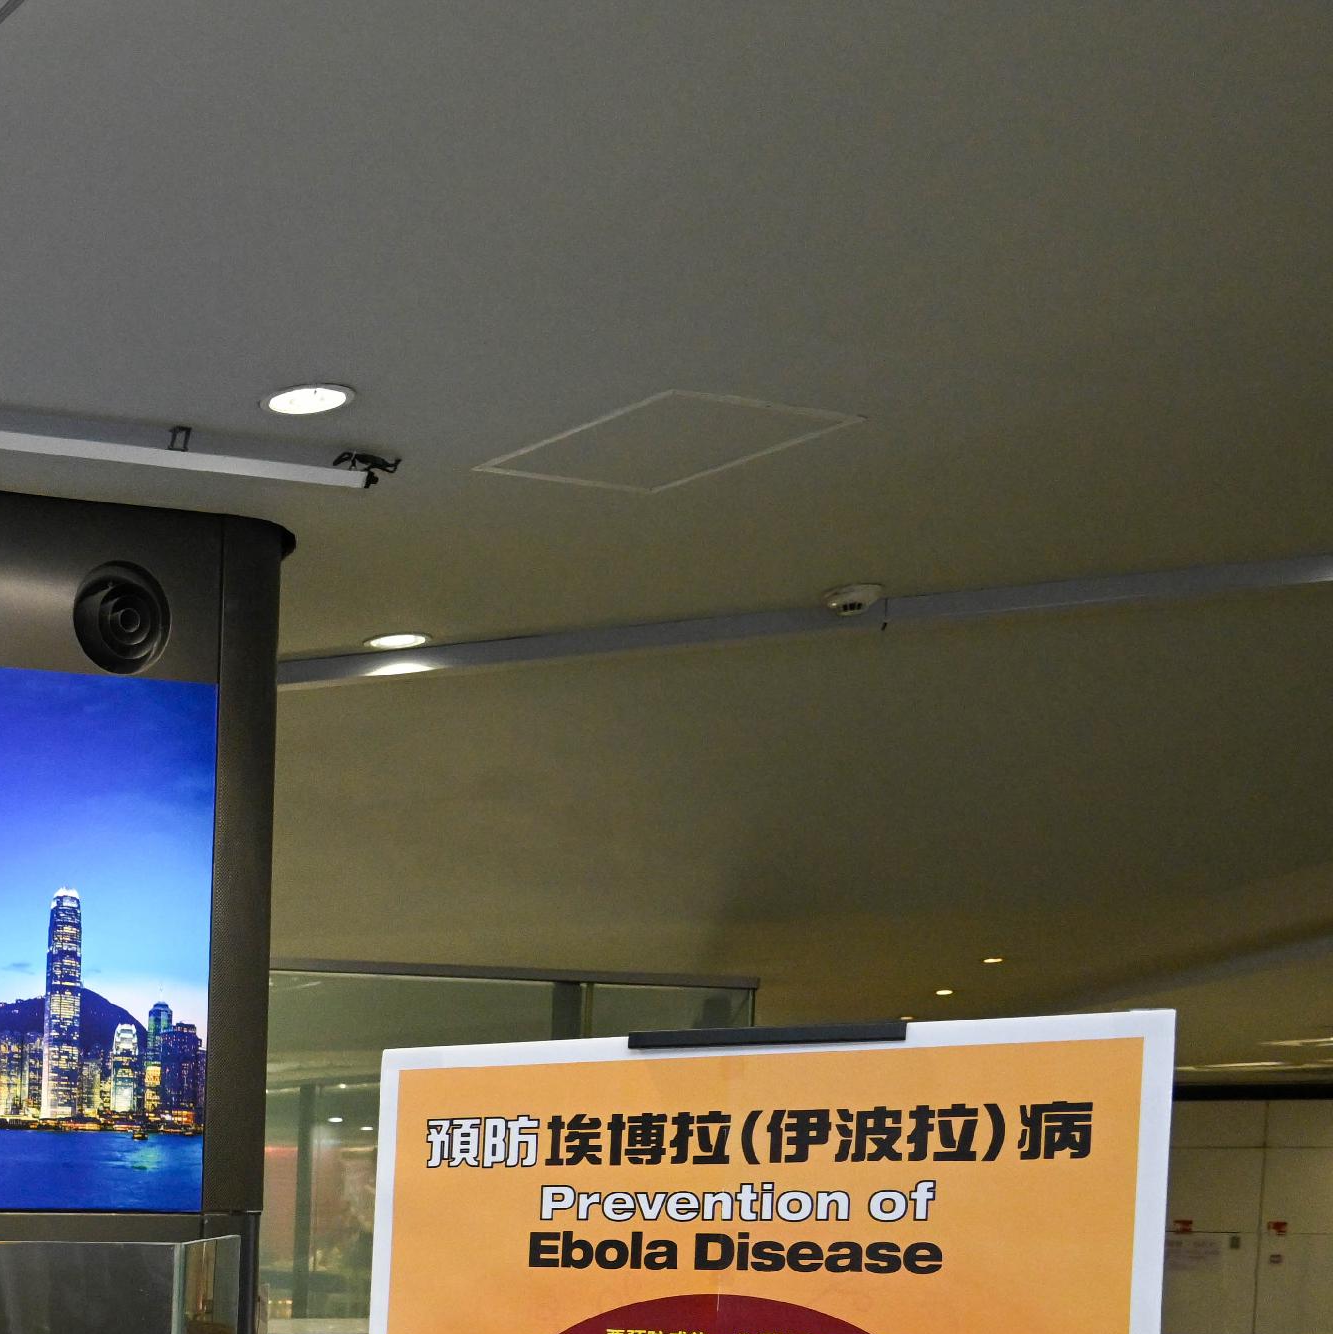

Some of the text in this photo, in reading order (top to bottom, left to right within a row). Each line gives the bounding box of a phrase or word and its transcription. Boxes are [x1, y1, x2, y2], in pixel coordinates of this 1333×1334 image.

[540, 1180, 936, 1223] Prevention of
[529, 1231, 943, 1275] Ebola Disease
